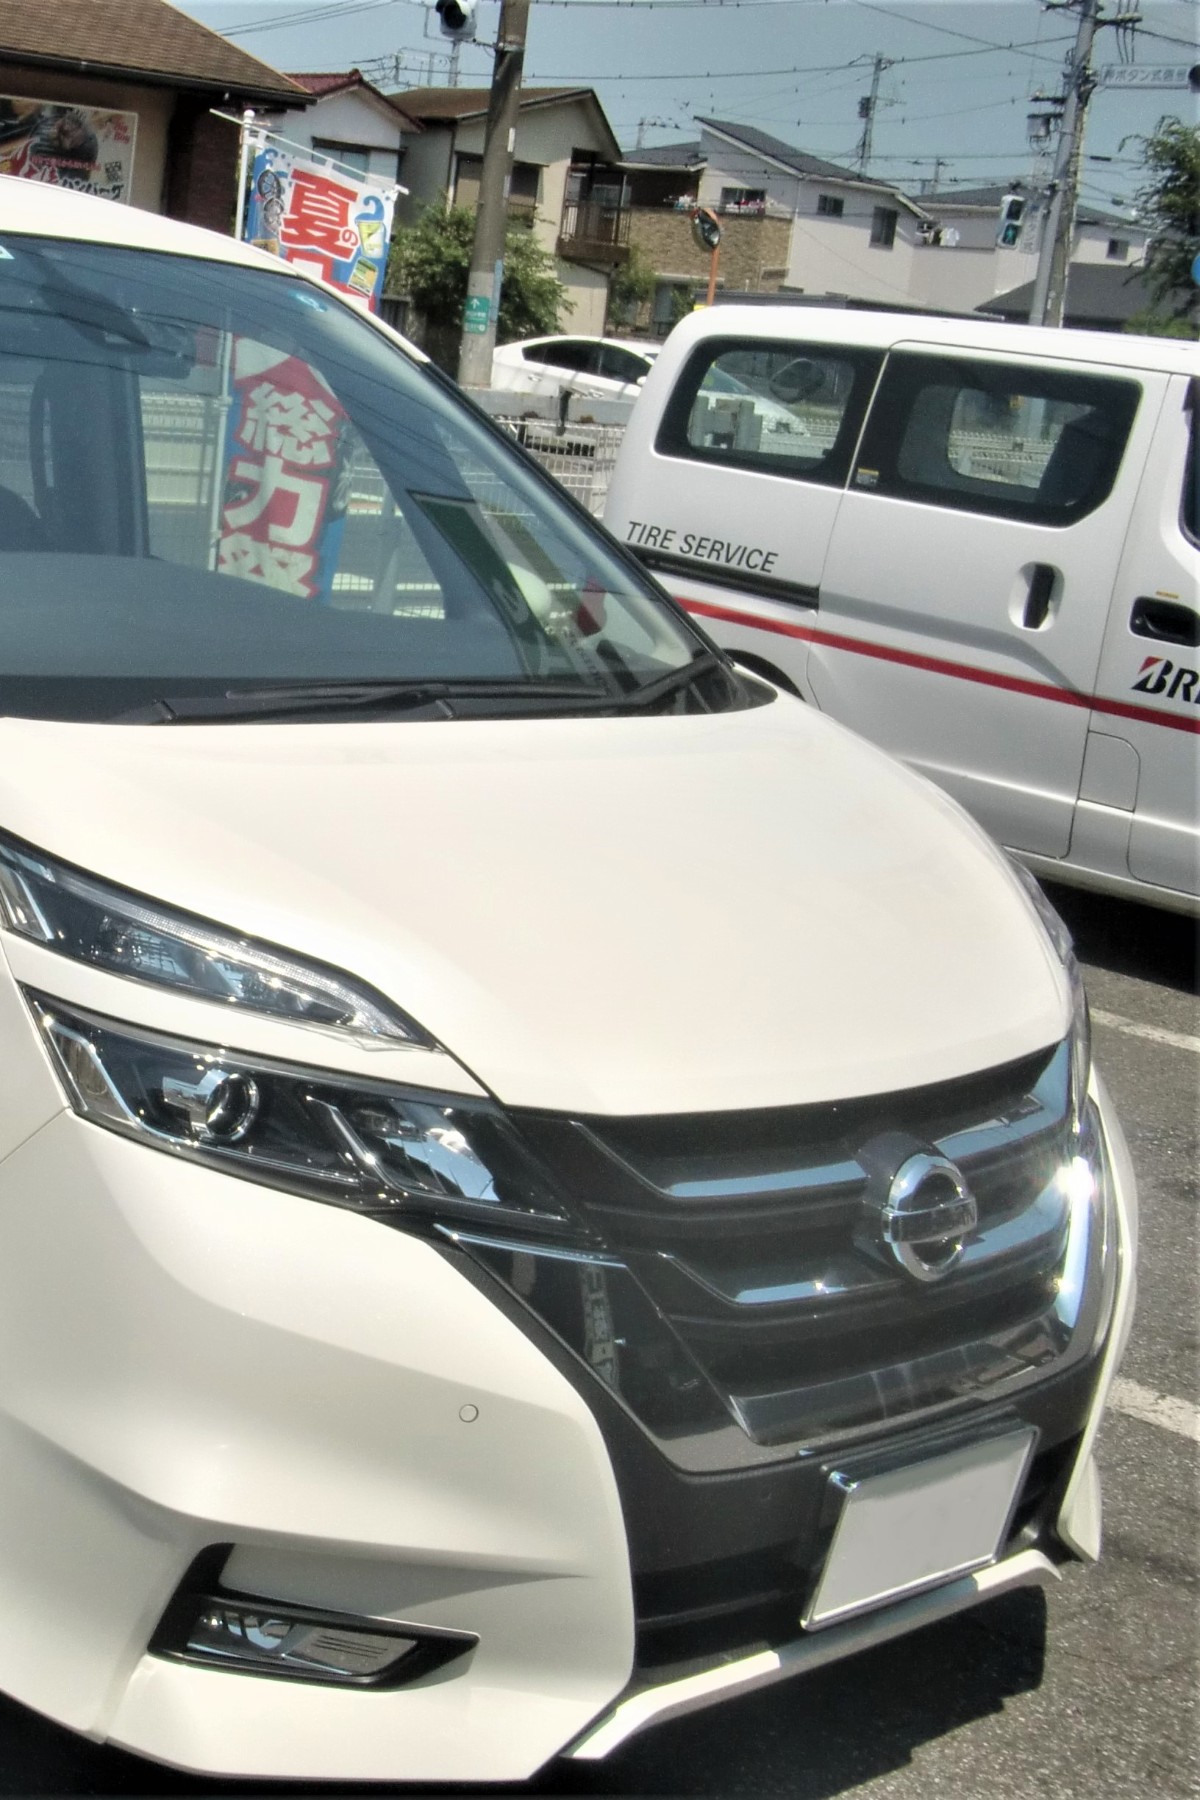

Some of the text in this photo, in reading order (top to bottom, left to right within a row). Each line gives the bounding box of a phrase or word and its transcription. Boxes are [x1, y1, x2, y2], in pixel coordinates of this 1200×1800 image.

[626, 520, 779, 573] TIRE SERVICE
[1131, 655, 1200, 704] BR
